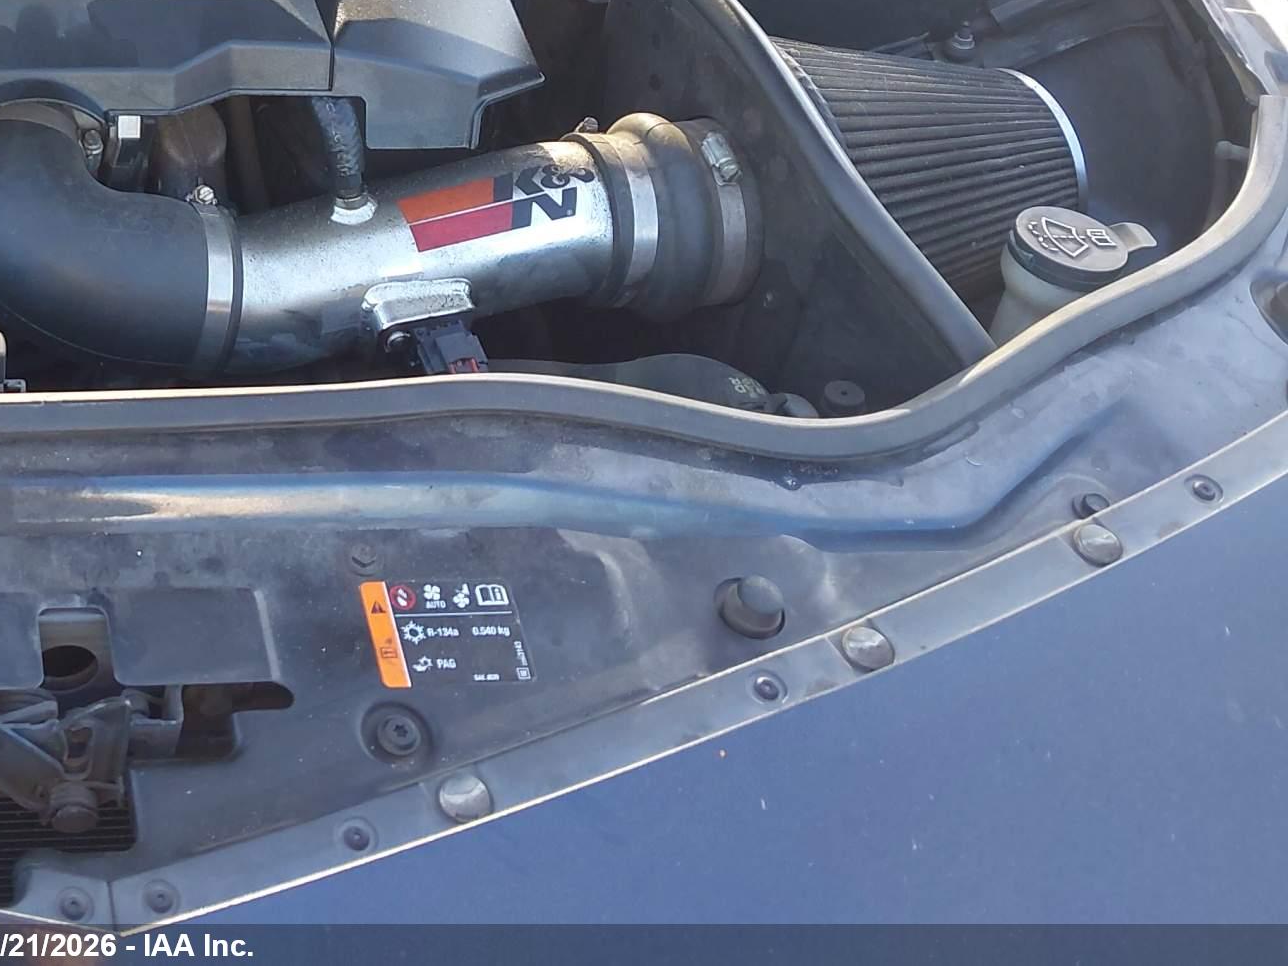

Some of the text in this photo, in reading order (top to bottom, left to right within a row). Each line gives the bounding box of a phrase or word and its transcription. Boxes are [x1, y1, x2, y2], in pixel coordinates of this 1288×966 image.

[426, 600, 447, 609] AUTO
[426, 626, 510, 637] R-134a 0.540 kg
[436, 658, 457, 669] PAG
